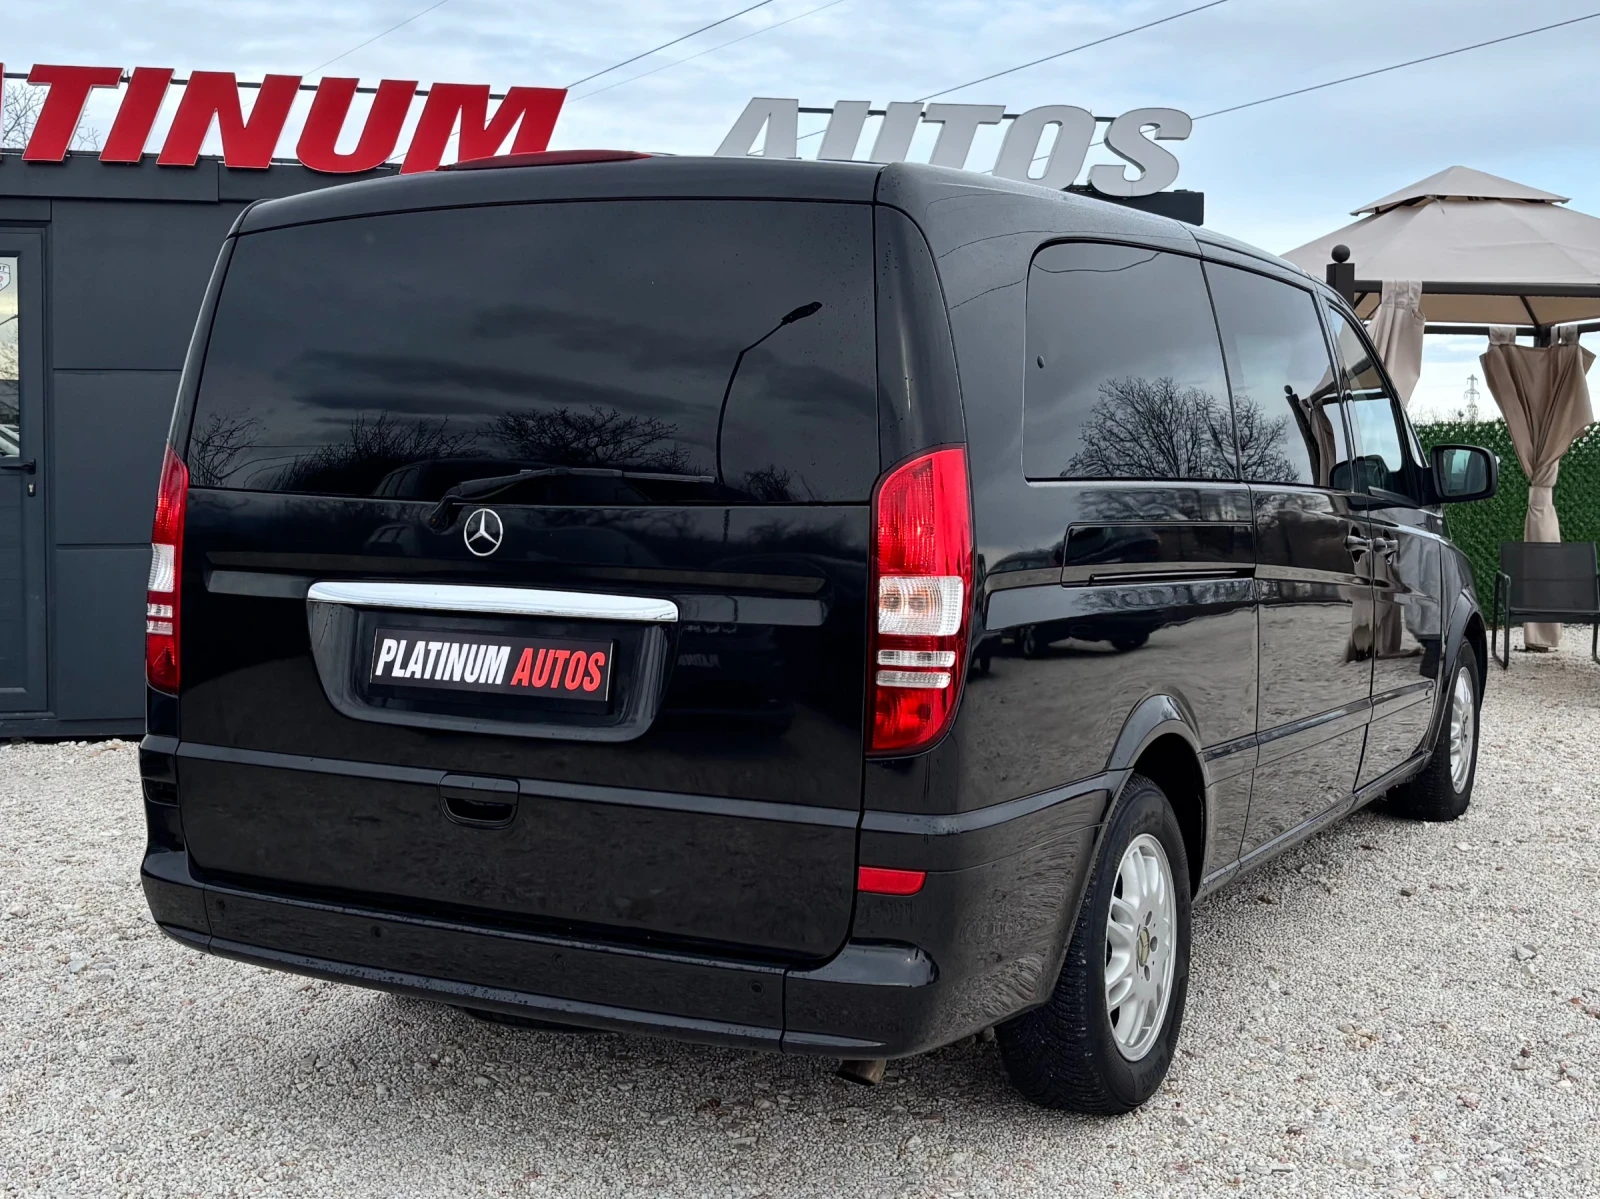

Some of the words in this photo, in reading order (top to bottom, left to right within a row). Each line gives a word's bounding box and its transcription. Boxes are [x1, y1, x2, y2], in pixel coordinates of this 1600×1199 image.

[0, 63, 568, 174] TINUM
[714, 97, 1193, 197] AUTOS
[375, 638, 511, 685] PLATINUM
[510, 647, 605, 692] AUTOS
